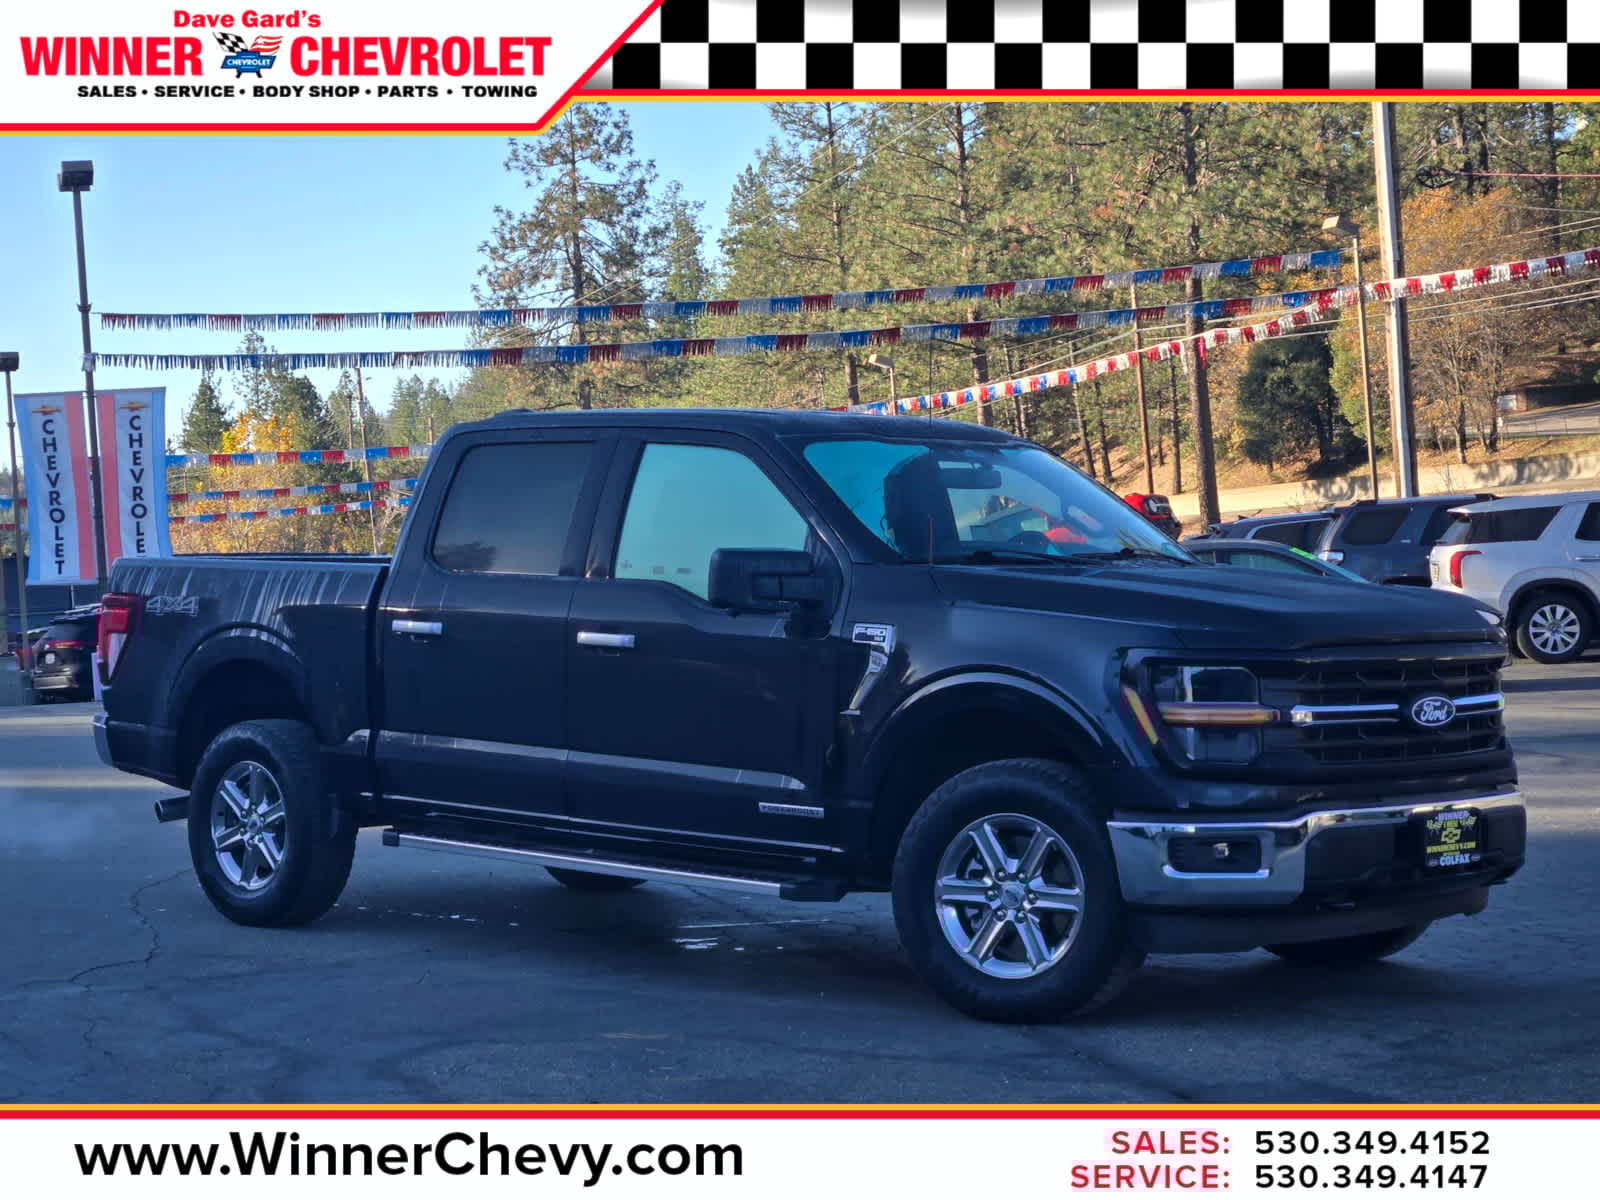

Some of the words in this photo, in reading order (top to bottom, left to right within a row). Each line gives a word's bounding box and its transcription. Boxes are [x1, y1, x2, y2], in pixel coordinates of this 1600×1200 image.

[42, 419, 65, 575] CHEVROLET
[128, 415, 148, 558] CHEVROLE
[1420, 701, 1448, 721] Ford
[1440, 854, 1471, 866] COLFAX
